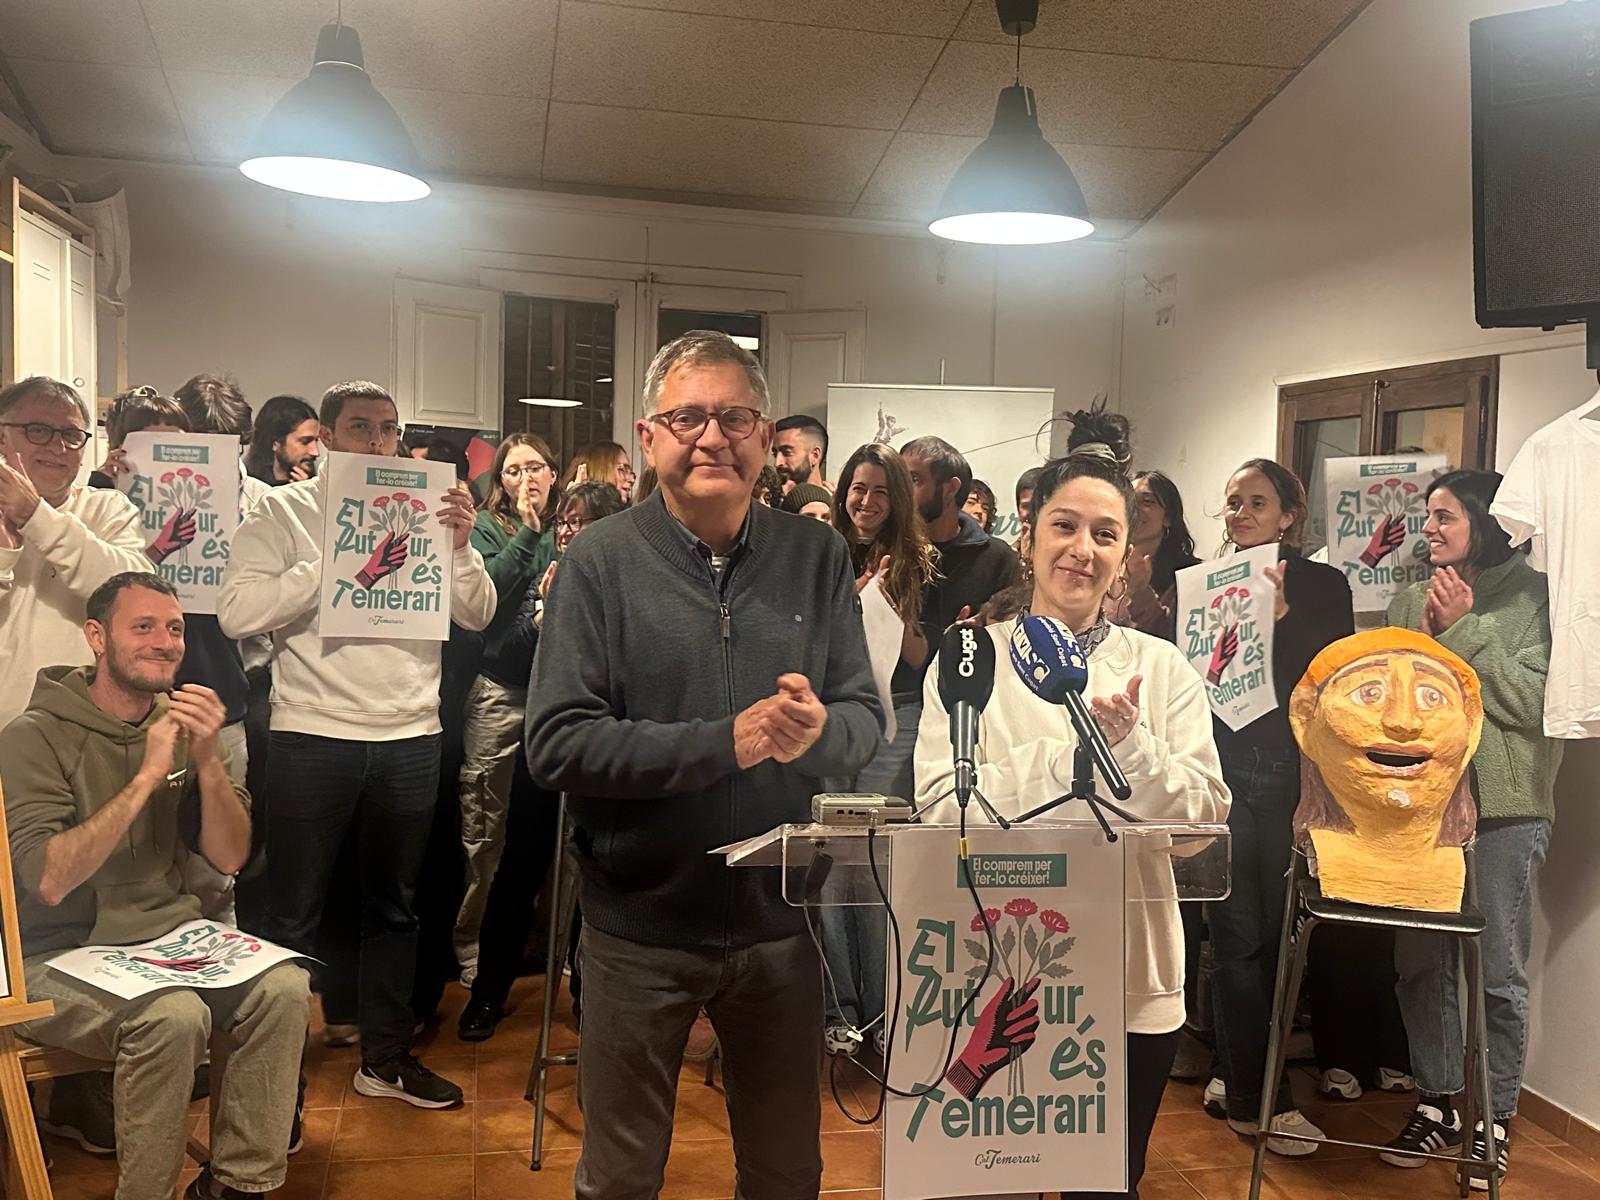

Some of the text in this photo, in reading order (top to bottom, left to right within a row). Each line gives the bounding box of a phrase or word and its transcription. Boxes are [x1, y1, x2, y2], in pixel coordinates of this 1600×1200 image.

[335, 497, 365, 527] El
[1336, 490, 1361, 515] El
[411, 553, 443, 585] és
[331, 578, 441, 612] Temerari
[1185, 606, 1206, 636] El
[958, 628, 978, 678] Cugat
[1243, 632, 1265, 667] és
[972, 857, 1053, 874] El comprem per
[975, 871, 1050, 885] fer-lo créixer!
[907, 918, 956, 976] El
[1049, 1014, 1107, 1081] és
[905, 1080, 1107, 1143] Temerari
[985, 1148, 1042, 1170] Temerari
